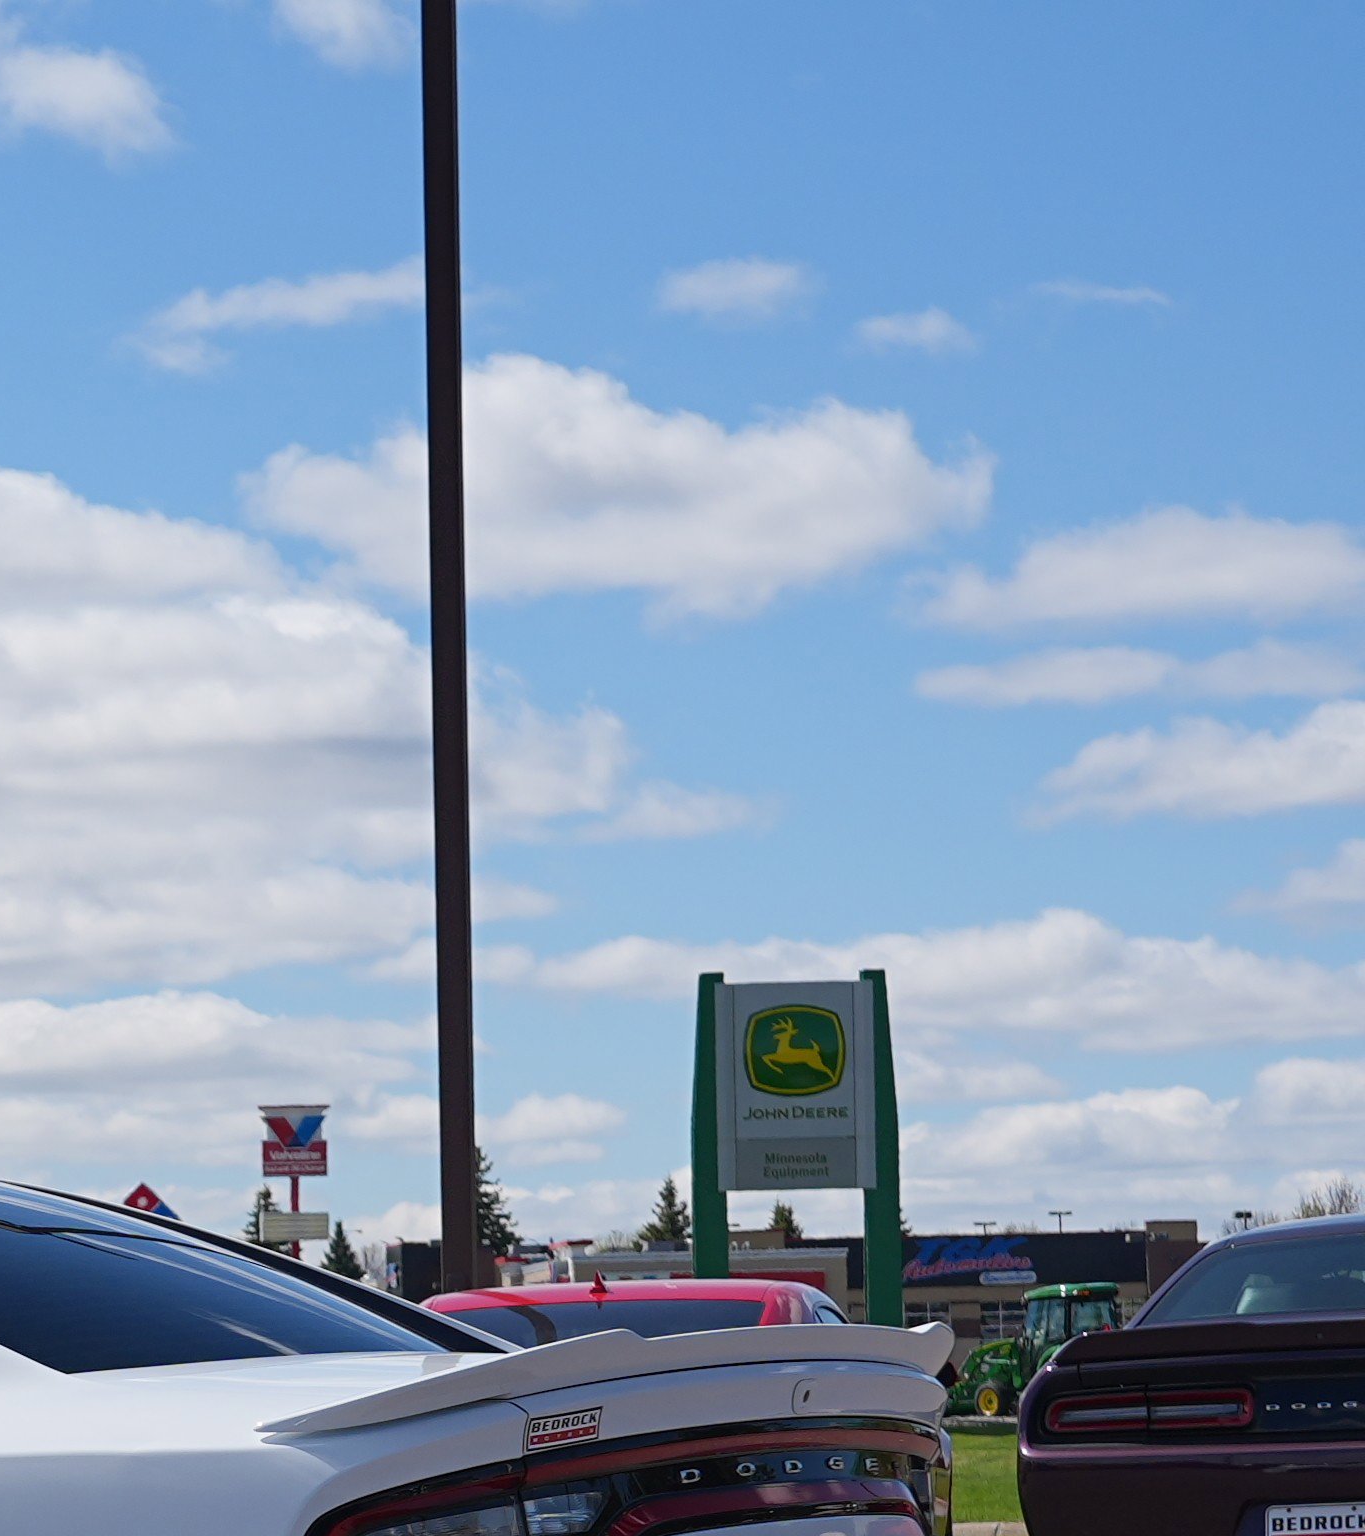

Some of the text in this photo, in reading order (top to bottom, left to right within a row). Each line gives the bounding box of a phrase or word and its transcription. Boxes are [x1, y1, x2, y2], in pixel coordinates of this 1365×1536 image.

[743, 1105, 849, 1120] JOHN DEERE
[764, 1152, 827, 1164] Minnesota
[763, 1166, 830, 1180] Equipment
[531, 1412, 597, 1433] BEDROCK
[680, 1456, 880, 1484] DODGE
